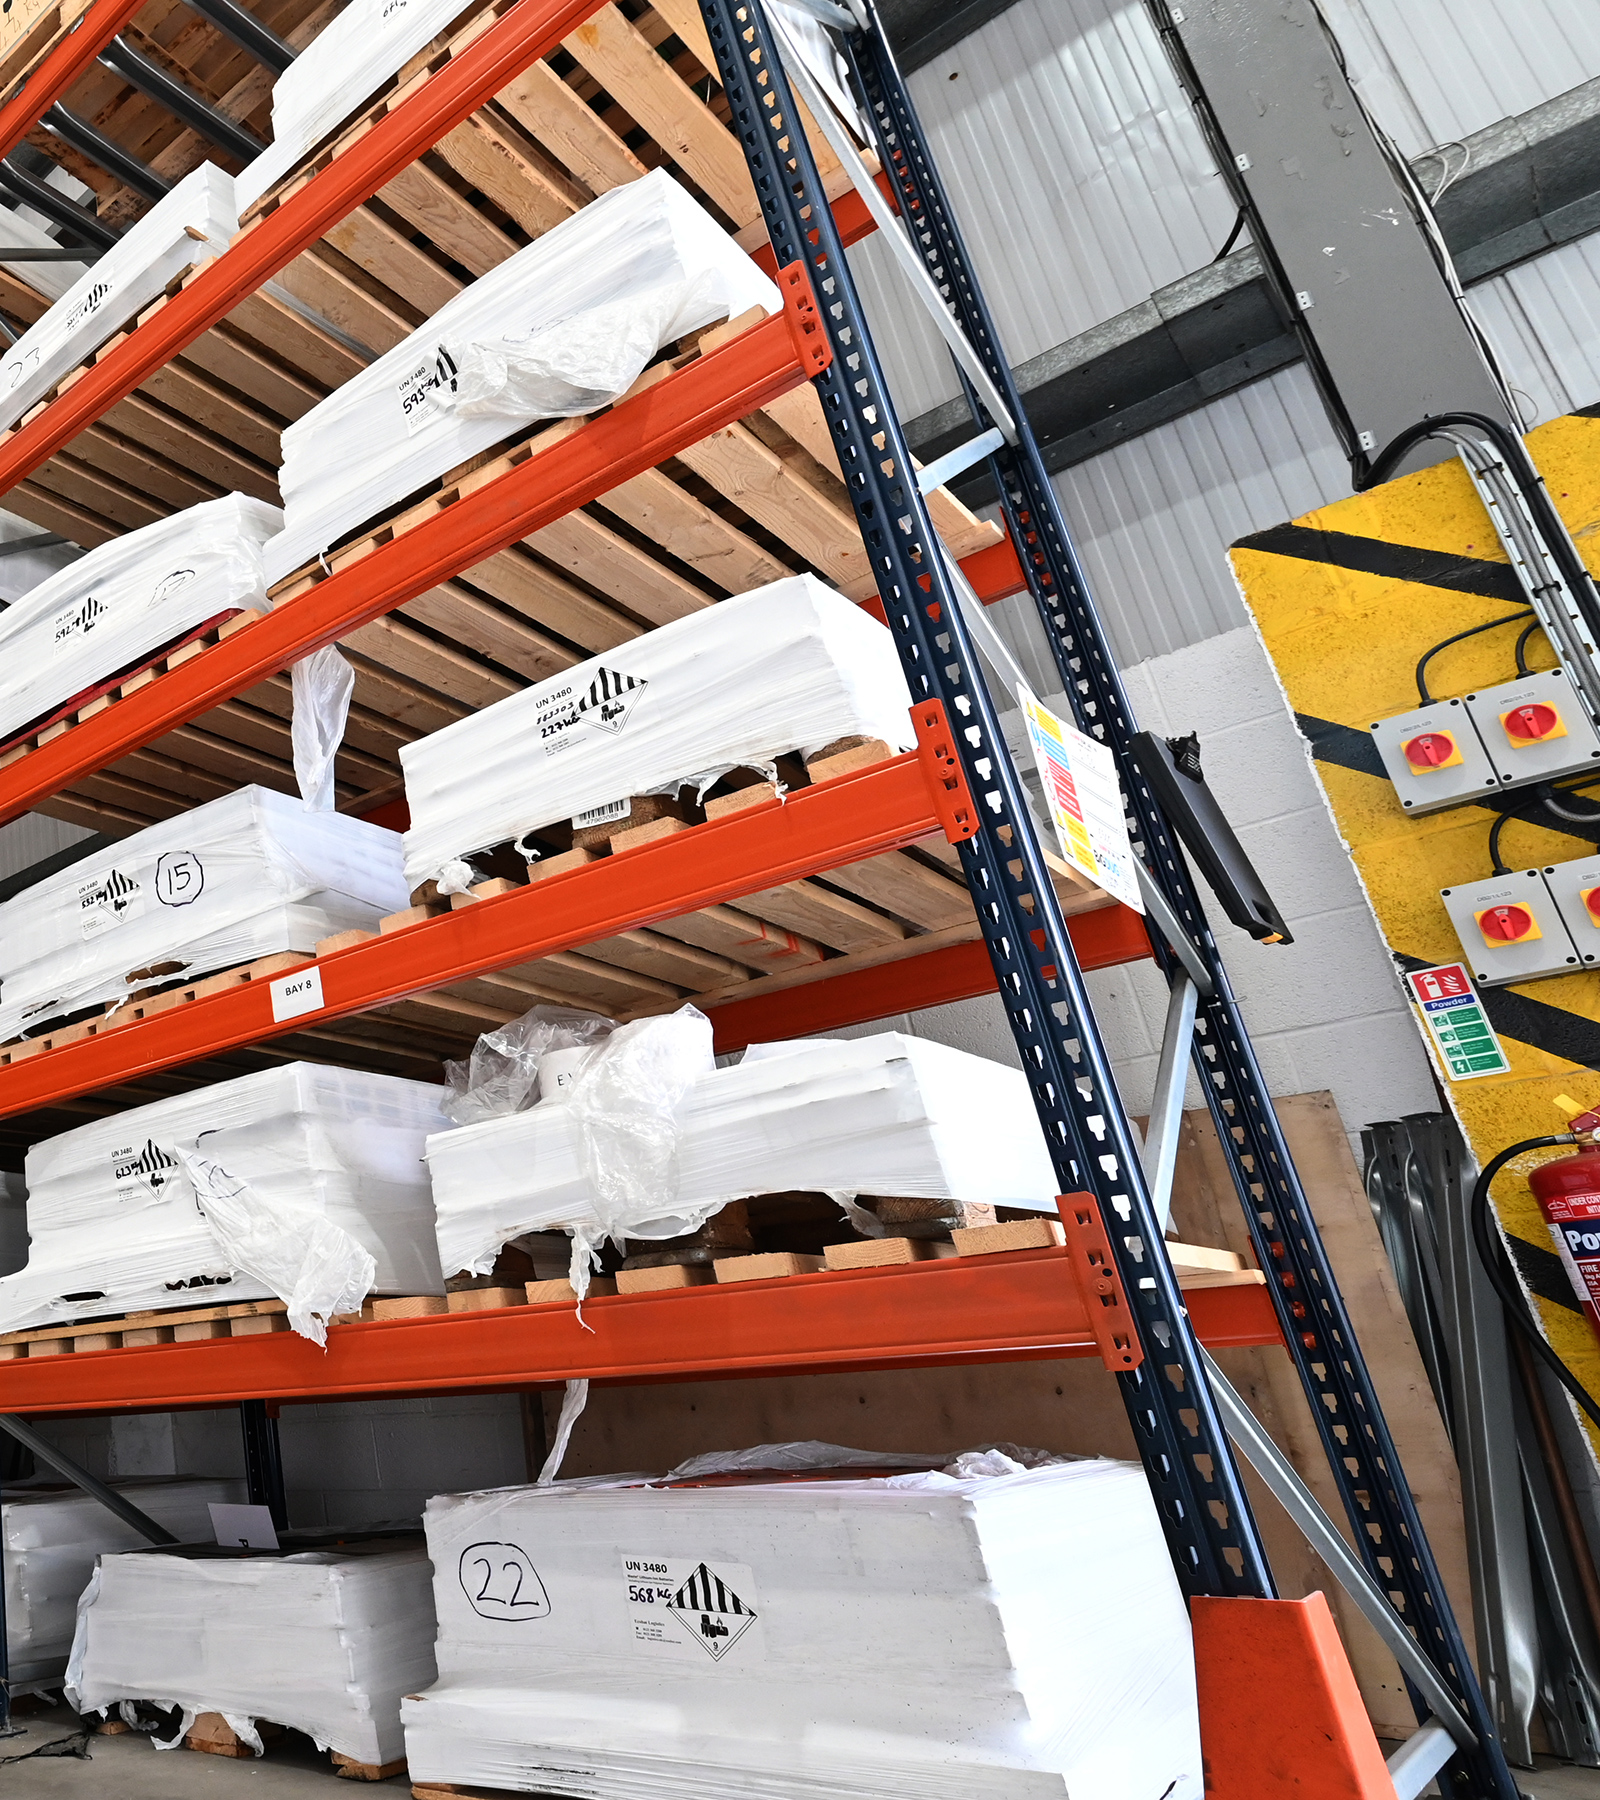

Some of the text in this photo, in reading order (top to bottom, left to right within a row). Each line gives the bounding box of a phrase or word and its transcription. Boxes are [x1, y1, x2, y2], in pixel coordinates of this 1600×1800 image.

[398, 379, 410, 391] UN
[403, 388, 425, 414] 593
[535, 697, 549, 709] UN
[551, 686, 572, 702] 3480
[167, 862, 191, 895] 15
[78, 885, 87, 895] UN
[285, 979, 312, 996] BAY 8
[1430, 997, 1467, 1009] Powder
[111, 1146, 133, 1158] UN 3480
[1580, 1264, 1599, 1273] FIRE
[625, 1561, 667, 1573] UN 3480
[473, 1558, 539, 1606] 22
[629, 1585, 654, 1604] 568
[712, 1641, 719, 1649] 9
